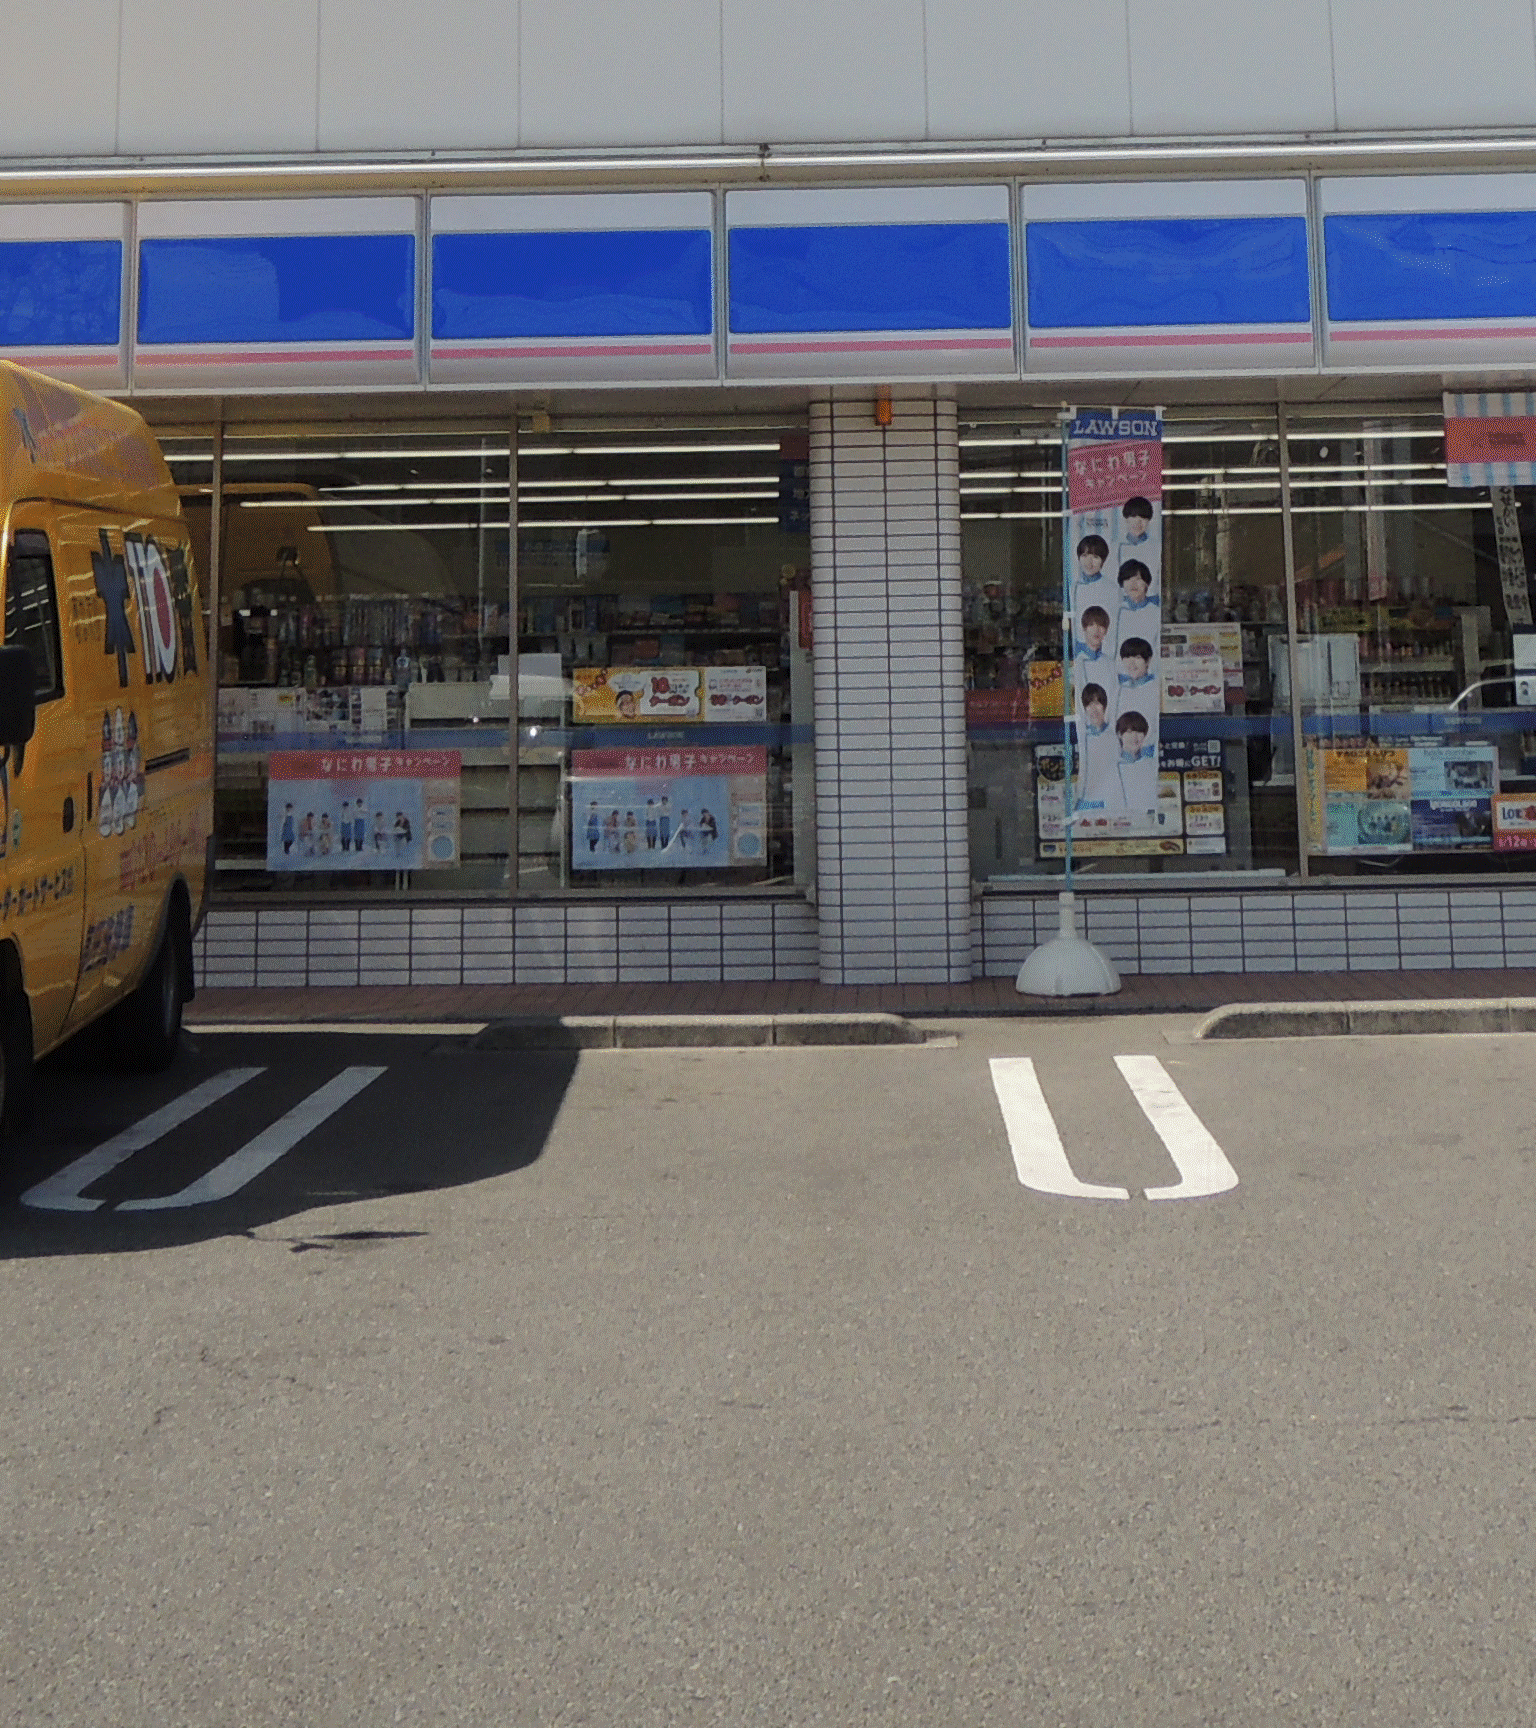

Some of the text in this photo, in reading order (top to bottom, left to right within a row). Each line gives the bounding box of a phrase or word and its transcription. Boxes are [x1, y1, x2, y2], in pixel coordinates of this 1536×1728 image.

[1073, 419, 1158, 437] LAWSON
[1073, 449, 1150, 476] なにわ男子
[321, 756, 392, 773] なにわ男子
[624, 753, 697, 772] なにわ男子
